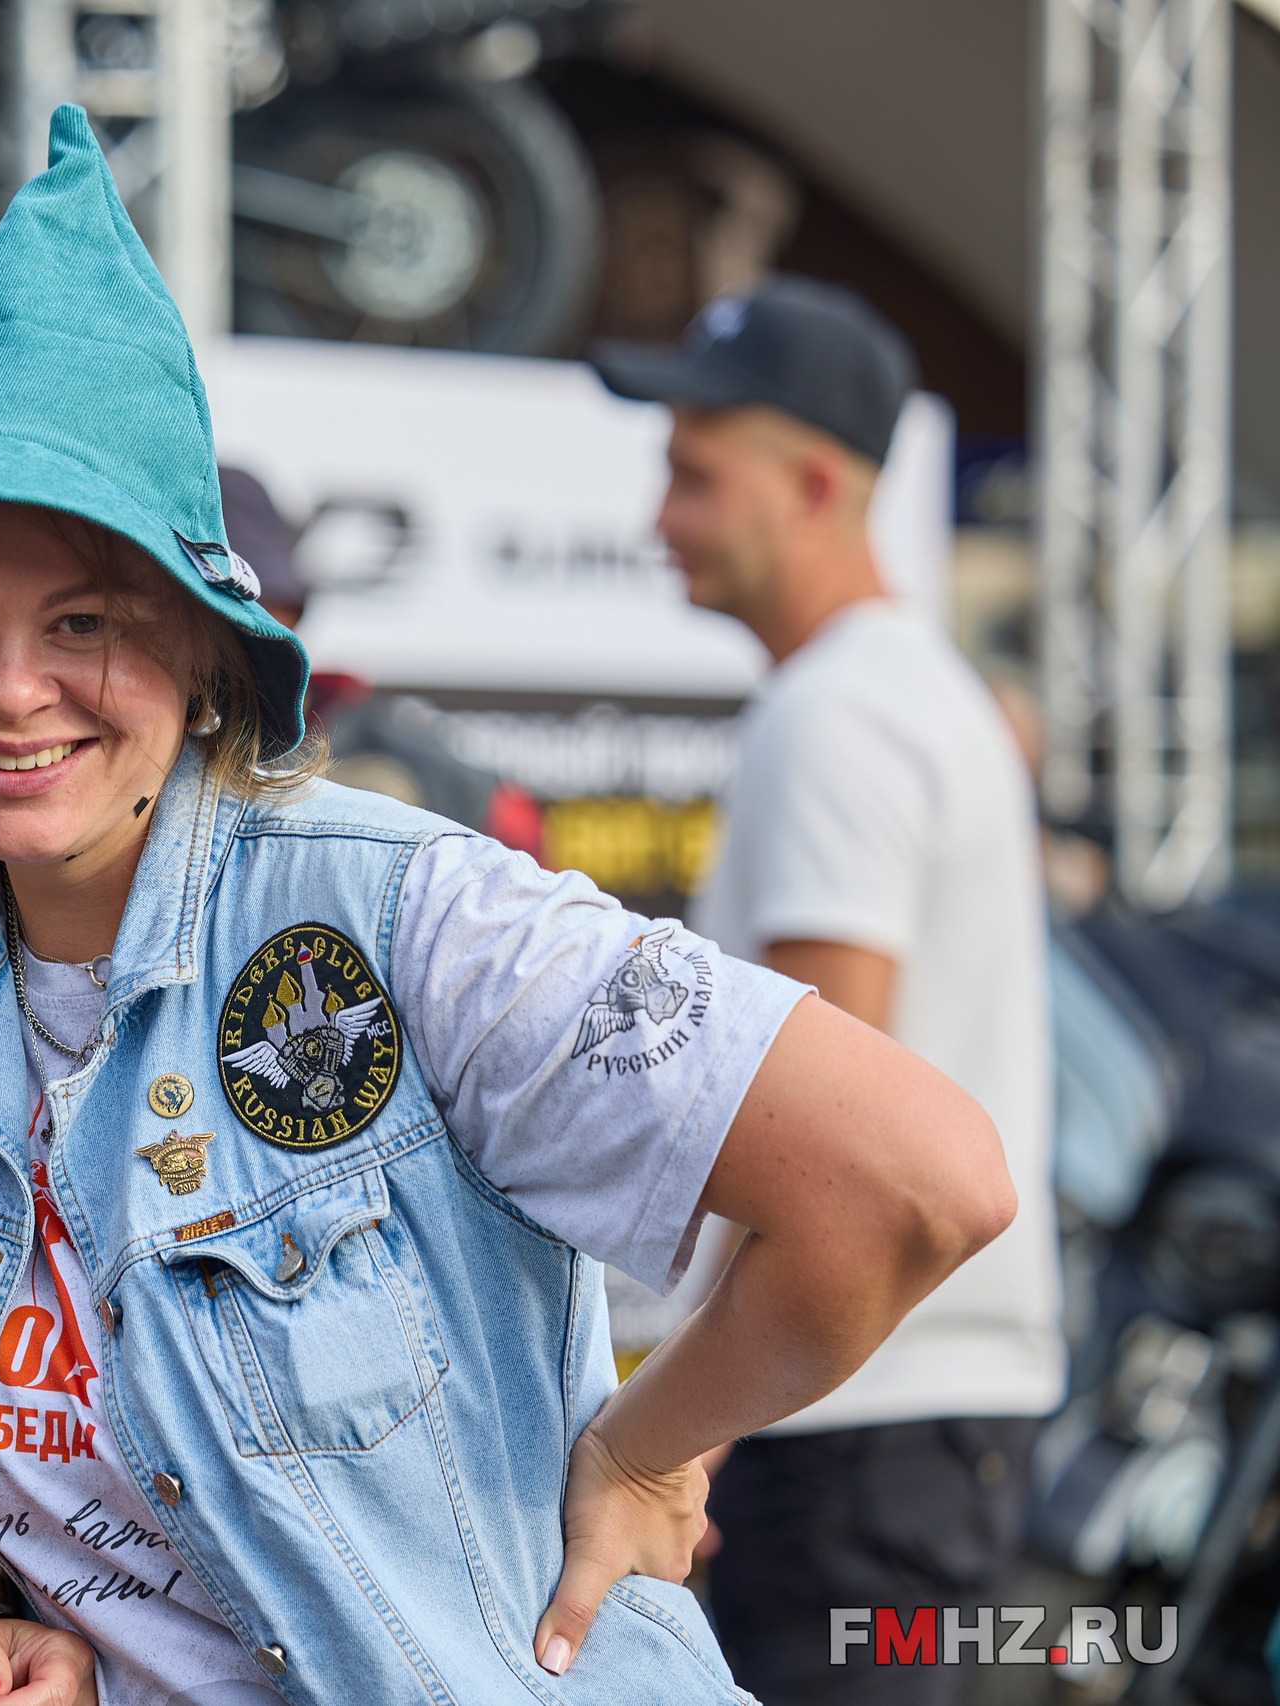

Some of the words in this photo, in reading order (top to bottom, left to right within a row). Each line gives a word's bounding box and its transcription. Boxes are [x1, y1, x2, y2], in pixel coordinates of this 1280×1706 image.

[366, 1020, 392, 1040] MCC
[586, 1029, 691, 1081] РУССКИЙ
[231, 1073, 352, 1140] RUSSIAN
[178, 1182, 197, 1195] 2013
